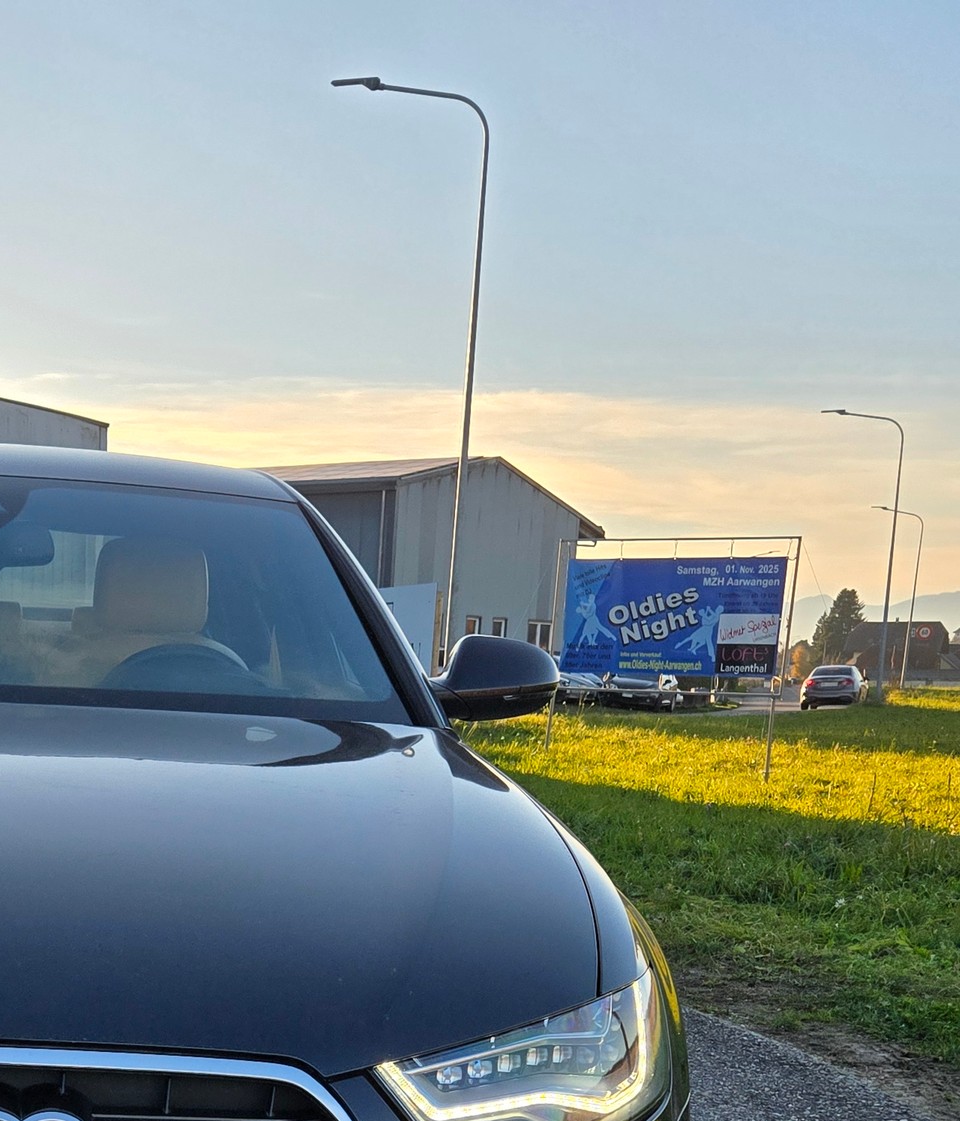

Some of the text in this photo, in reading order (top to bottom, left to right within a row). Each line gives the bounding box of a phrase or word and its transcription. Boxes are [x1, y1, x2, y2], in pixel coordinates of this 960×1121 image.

[677, 564, 779, 576] Samstag, 01. Nov. 2025
[703, 577, 780, 588] MZH Aarwangen
[608, 585, 700, 626] Oldies
[618, 605, 699, 646] Night
[618, 659, 702, 672] www.Oldies-Night-Aarwangen.ch
[720, 662, 768, 674] Langenthal
